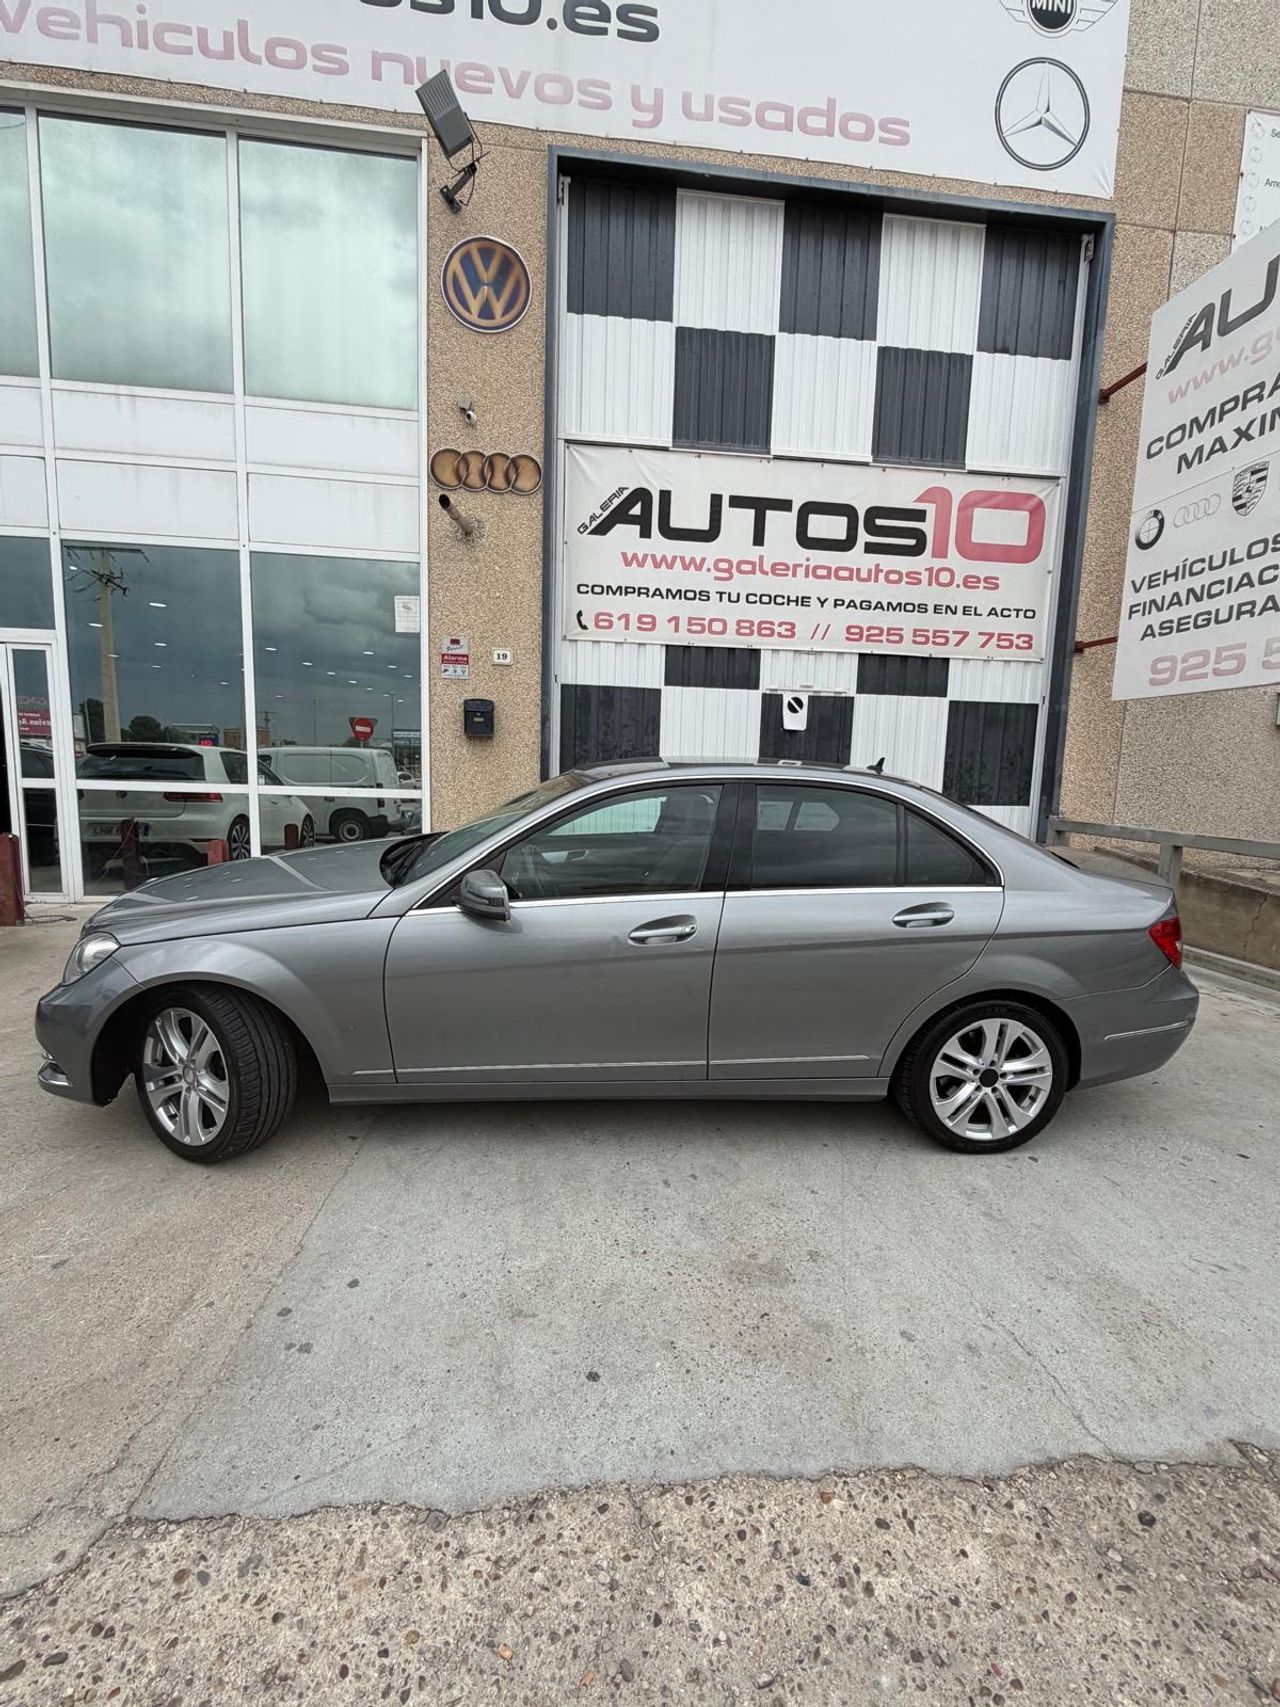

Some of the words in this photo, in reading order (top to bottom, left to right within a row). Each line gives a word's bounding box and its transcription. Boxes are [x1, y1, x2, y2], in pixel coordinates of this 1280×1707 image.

[1031, 0, 1072, 15] MINI
[630, 84, 664, 129] y
[681, 91, 911, 146] usados
[577, 486, 630, 535] GALERIA
[586, 486, 1047, 565] AUTOS10
[621, 552, 1001, 592] www.galeriaautos10.es
[576, 583, 711, 602] COMPRAMOS
[715, 591, 741, 604] TU
[745, 592, 812, 608] COCHE
[816, 596, 829, 608] Y
[833, 598, 929, 614] PAGAMOS
[933, 603, 958, 616] EN
[962, 605, 983, 617] EL
[986, 606, 1037, 620] ACTO
[593, 611, 658, 633] 619
[667, 615, 728, 637] 150
[735, 619, 797, 641] 863
[844, 623, 905, 645] 925
[911, 628, 970, 648] 557
[977, 631, 1034, 651] 753
[496, 652, 508, 661] 19
[1149, 642, 1247, 687] 925
